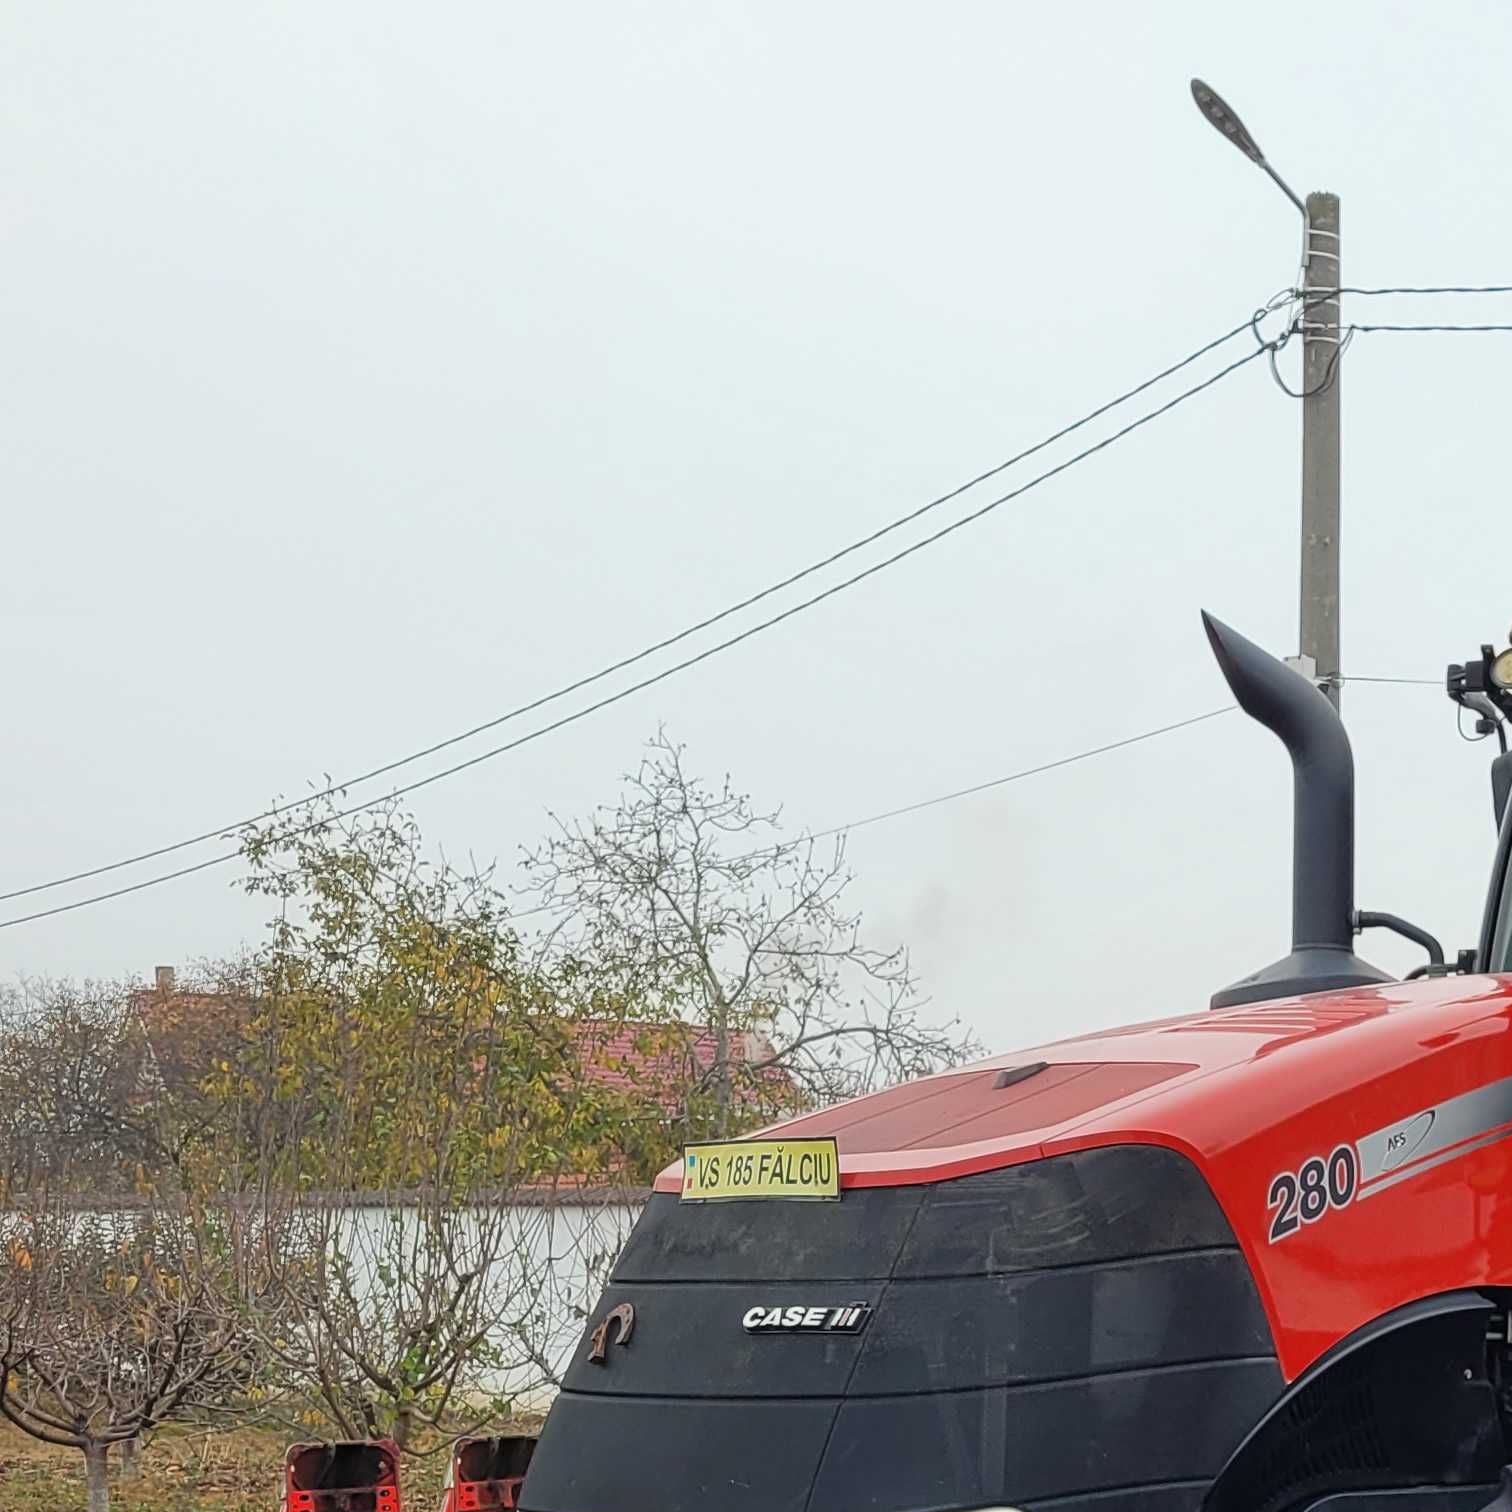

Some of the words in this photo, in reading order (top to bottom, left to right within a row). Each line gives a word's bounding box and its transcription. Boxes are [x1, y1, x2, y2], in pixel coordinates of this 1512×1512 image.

[1387, 1131, 1407, 1153] AFS
[700, 1156, 720, 1189] VS
[726, 1155, 753, 1187] 185
[758, 1146, 832, 1186] FĂLCIU
[1268, 1145, 1356, 1242] 280
